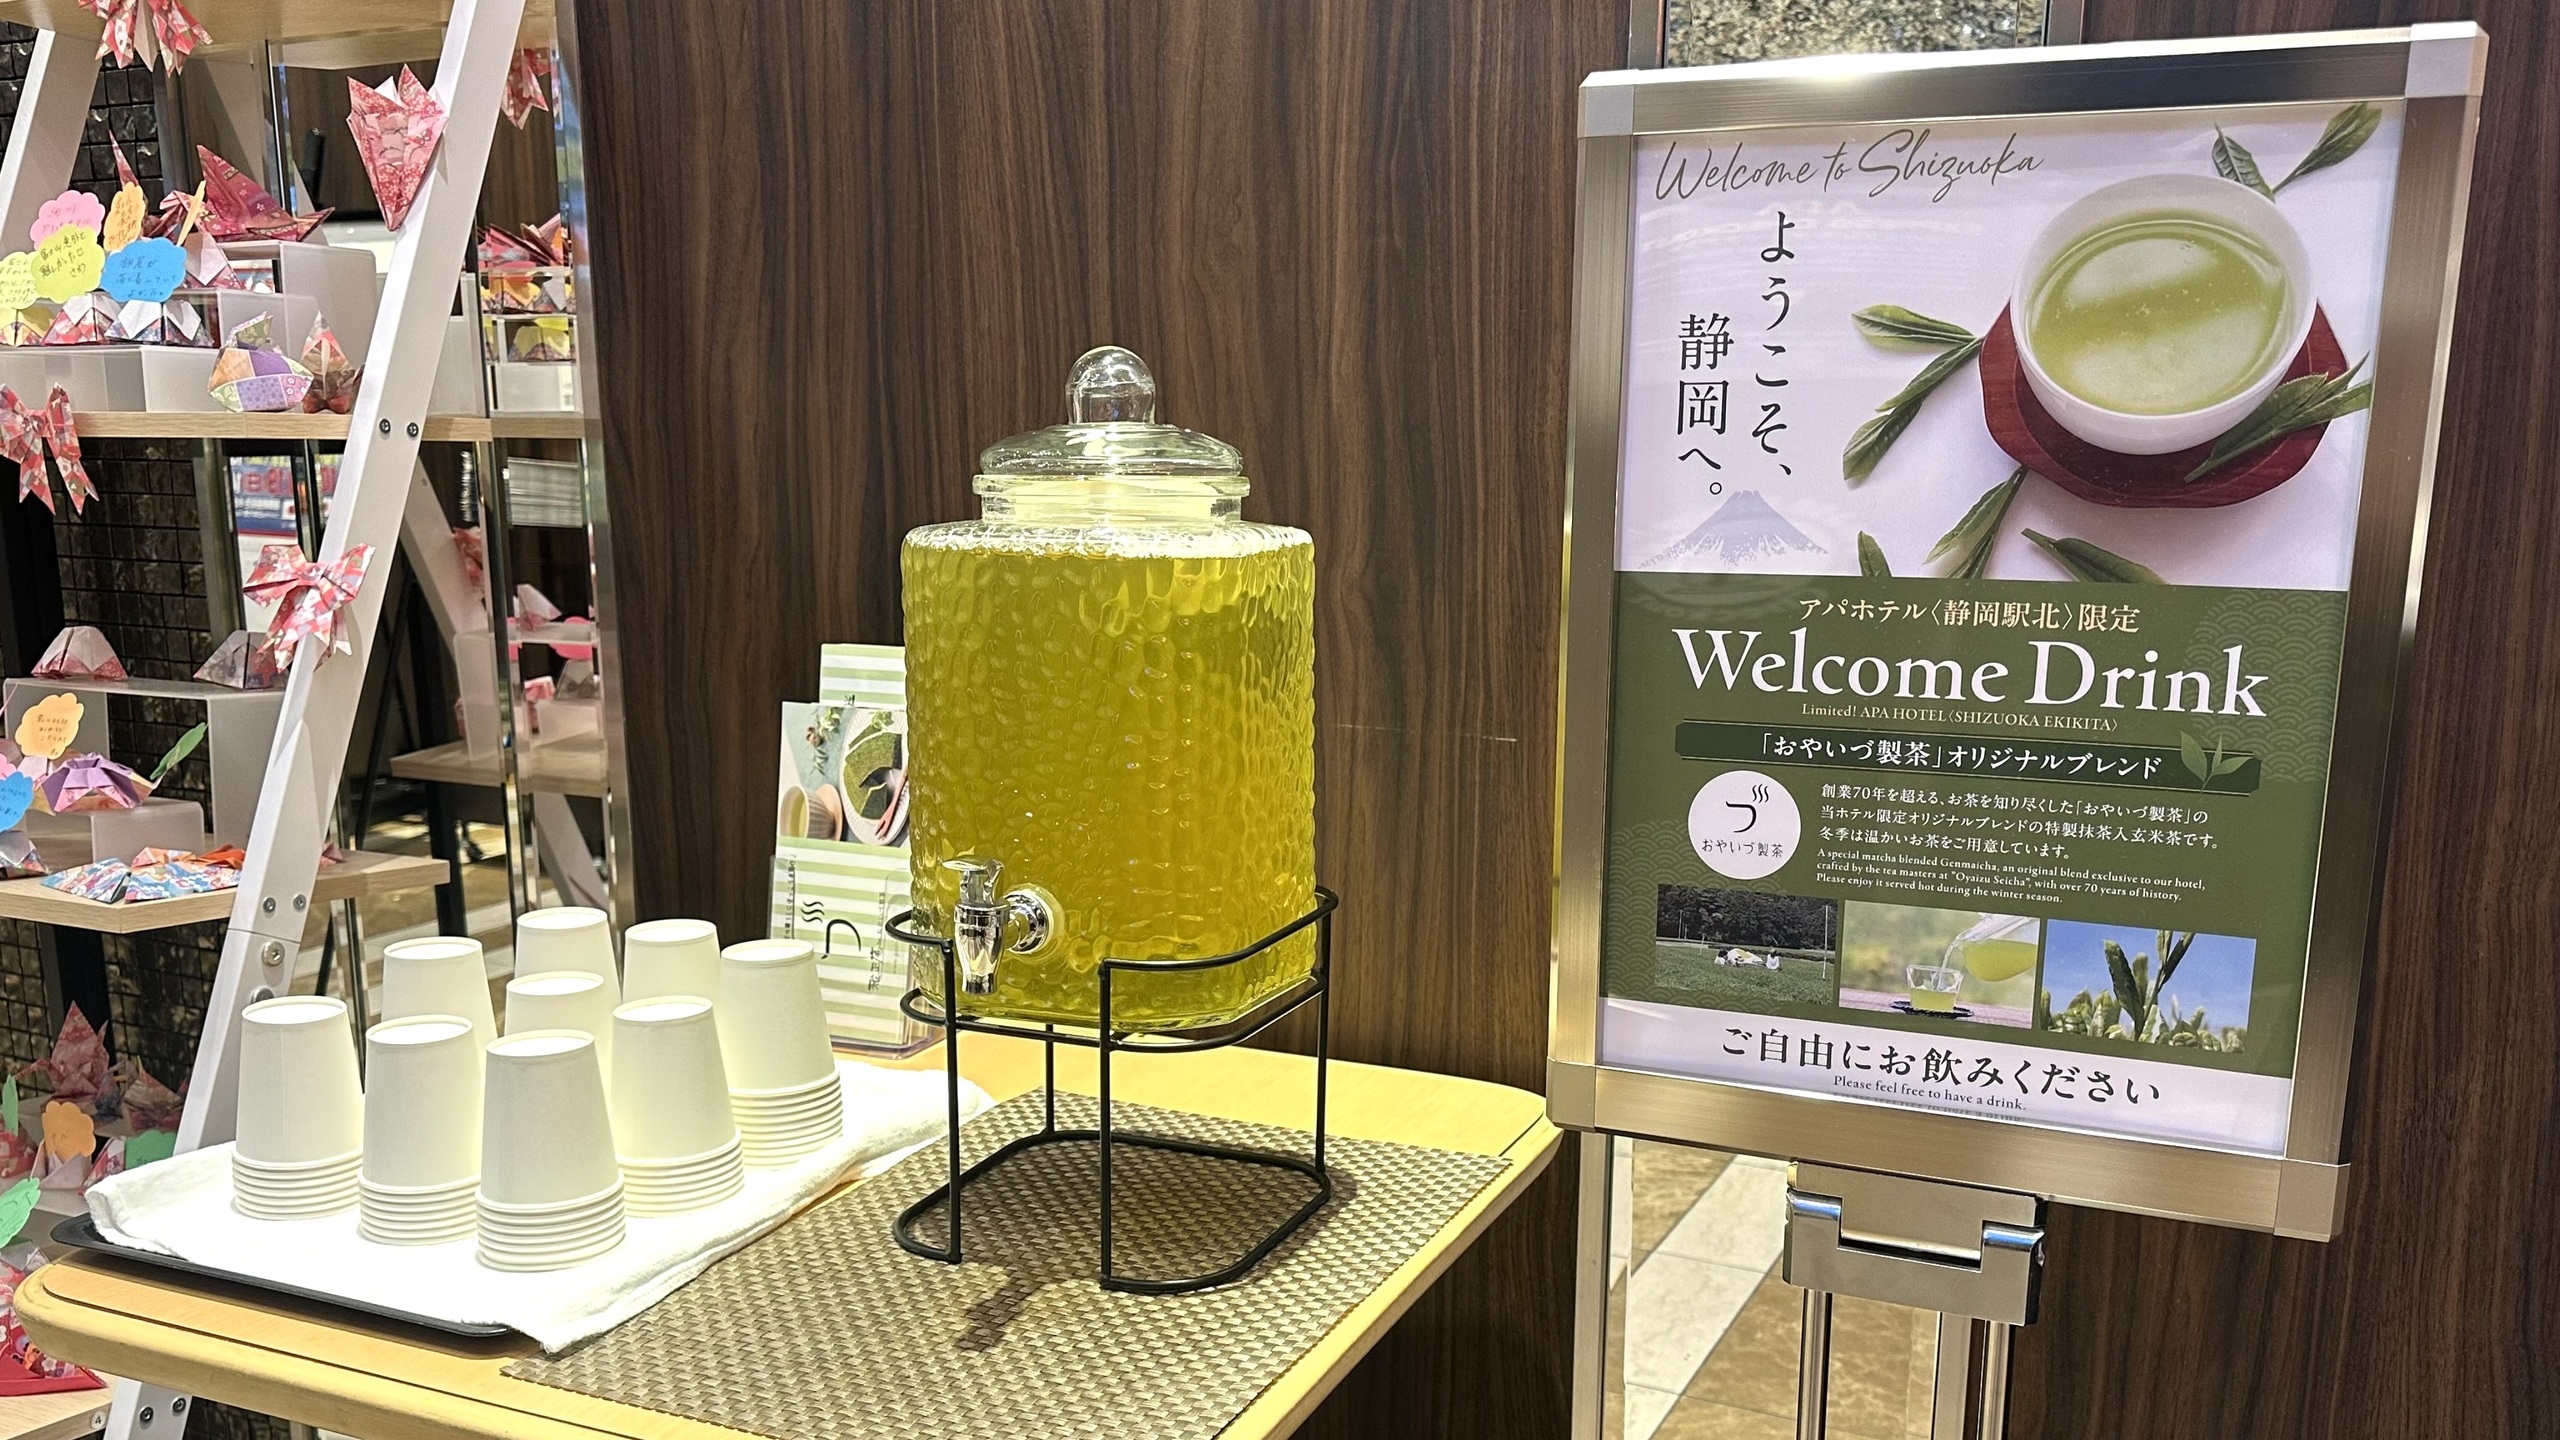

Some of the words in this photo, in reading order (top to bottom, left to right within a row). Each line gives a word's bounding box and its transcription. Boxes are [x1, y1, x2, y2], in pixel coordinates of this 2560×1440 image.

[1656, 141, 1817, 200] Welcome
[1823, 142, 1853, 192] to
[1858, 128, 2045, 203] Shizuoka
[1752, 211, 1795, 476] ようこそ、
[1677, 313, 1734, 495] 静岡へ。
[1799, 598, 2140, 633] アパホテル〈静岡駅北〉限定
[1671, 626, 2009, 703] Welcome
[2024, 640, 2269, 717] Drink
[1802, 703, 1857, 718] Limited!
[1861, 706, 1889, 720] APA
[1762, 733, 2162, 780] 「おやいづ製茶」オリジナルブレンド
[1701, 838, 1783, 858] おやいづ製茶
[1819, 826, 2069, 859] 冬季は温かいお茶をご用意しています。
[1816, 860, 1849, 872] crafted
[1851, 863, 1863, 875] by
[1865, 865, 1881, 874] the
[1882, 867, 1897, 876] tea
[1899, 869, 1936, 879] masters
[1939, 871, 1948, 880] at
[2034, 880, 2057, 890] with
[2059, 883, 2081, 892] over
[2084, 883, 2098, 893] 70
[2100, 886, 2126, 898] years
[2129, 886, 2142, 897] of
[2142, 888, 2182, 903] history.
[1816, 873, 1845, 884] Please
[1847, 876, 1873, 887] enjoy
[1876, 878, 1883, 886] it
[1885, 879, 1916, 890] served
[1918, 882, 1935, 892] hot
[1937, 884, 1970, 897] during
[1973, 887, 1989, 896] the
[1991, 888, 2023, 899] winter
[2026, 893, 2063, 903] season.
[1817, 848, 1826, 858] A
[1828, 850, 1859, 862] special
[1862, 853, 1897, 863] matcha
[1899, 854, 1938, 866] blended
[1940, 858, 2000, 872] Genmaicha,
[2003, 865, 2014, 873] an
[2017, 864, 2058, 877] original
[2060, 866, 2089, 879] blend
[2091, 871, 2138, 884] exclusive
[2140, 875, 2151, 885] to
[2154, 877, 2172, 886] our
[2175, 878, 2206, 891] hotel,
[1722, 1028, 2160, 1104] ご自由にお飲みください
[1833, 1074, 1872, 1091] Please
[1875, 1078, 1898, 1094] feel
[1901, 1082, 1925, 1097] free
[1928, 1087, 1941, 1099] to
[1945, 1088, 1973, 1103] have
[1976, 1095, 1983, 1105] a
[1986, 1094, 2027, 1111] drink.
